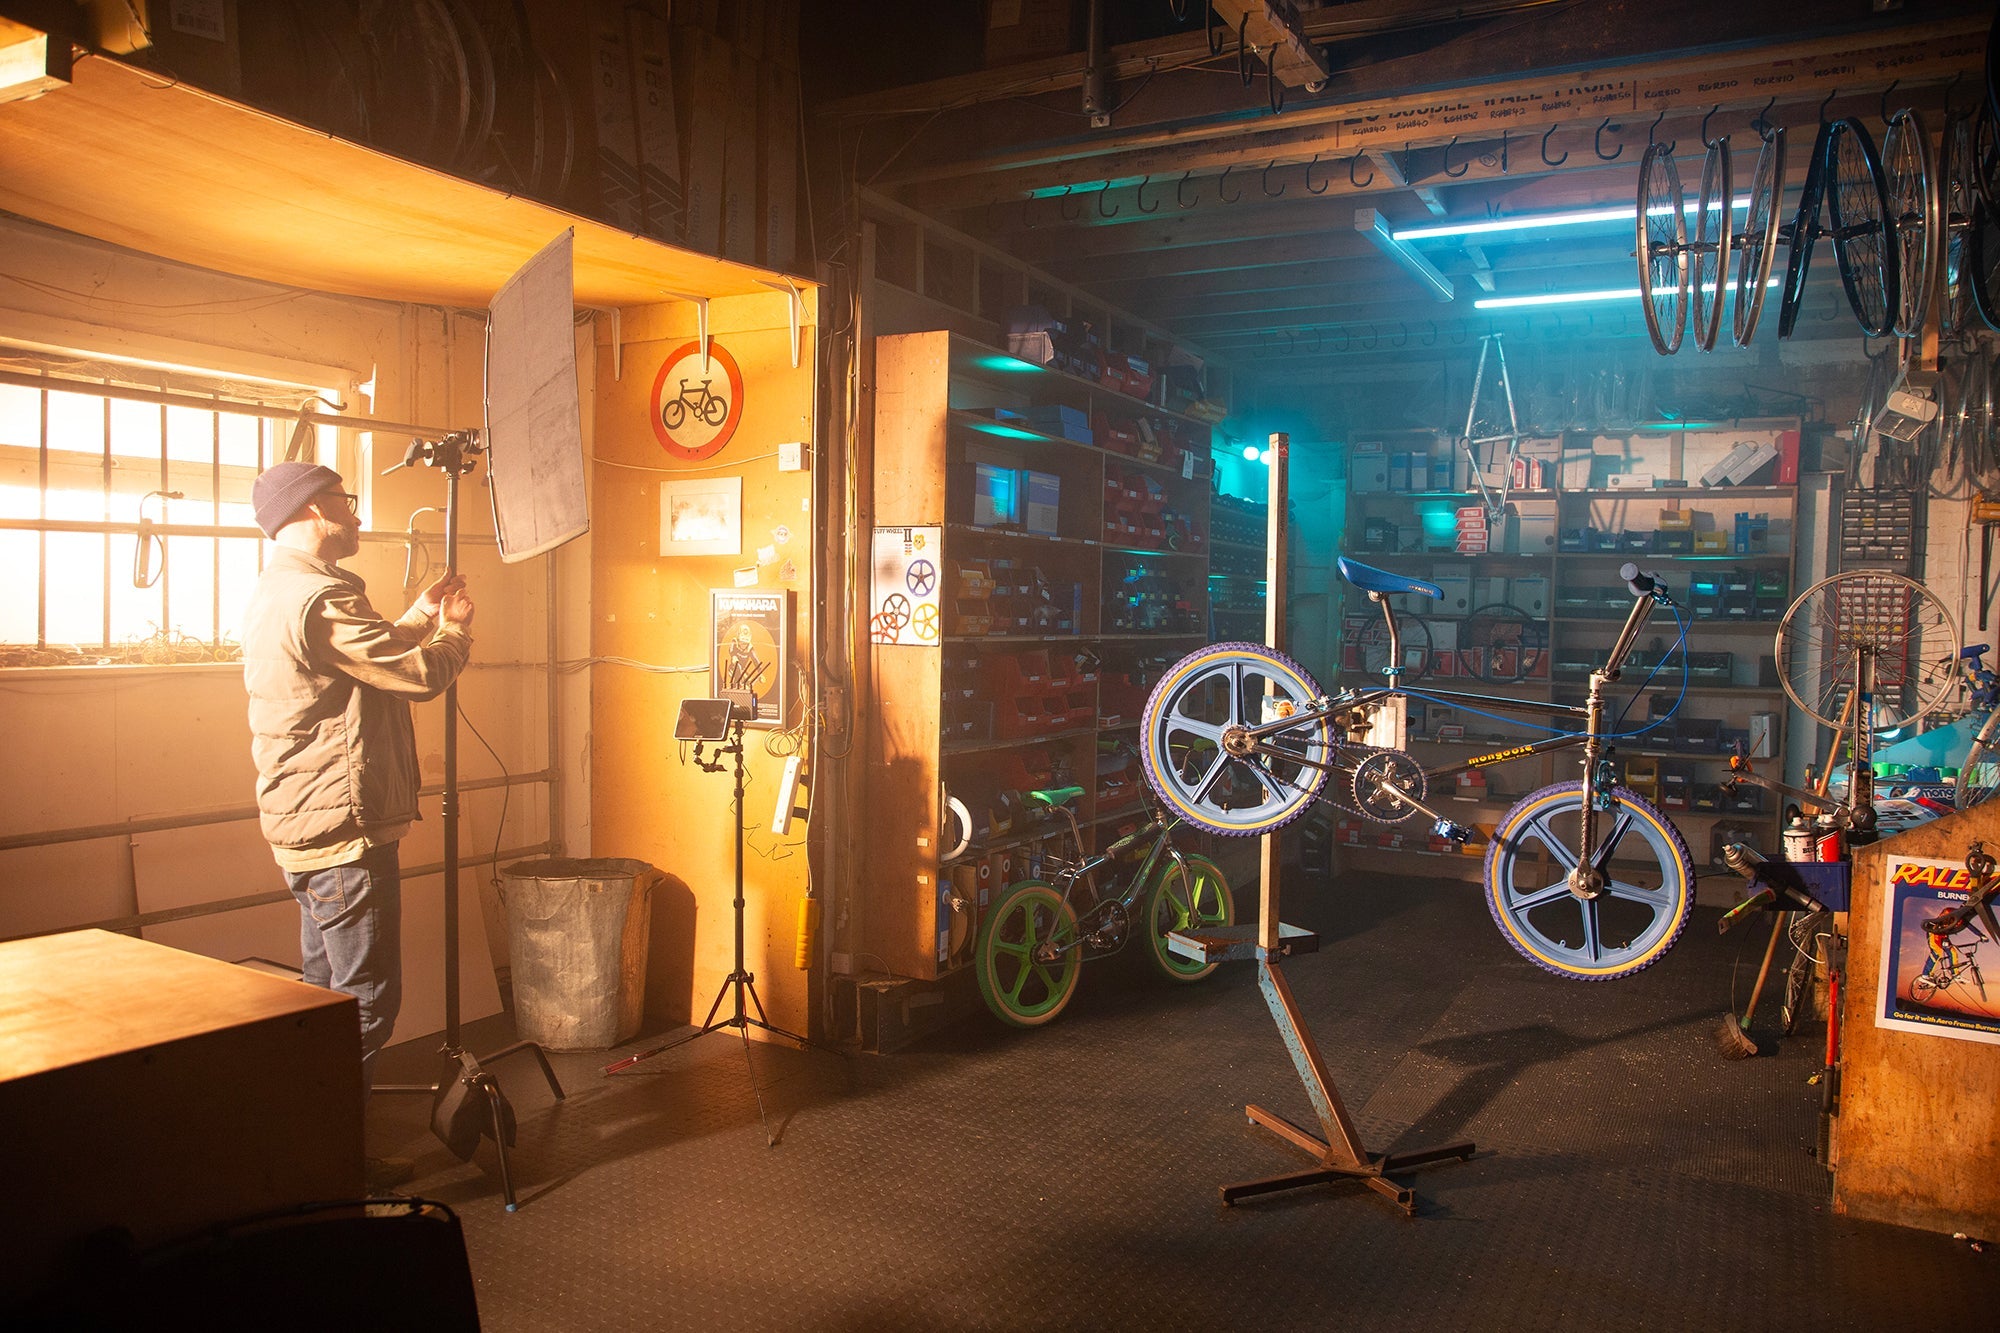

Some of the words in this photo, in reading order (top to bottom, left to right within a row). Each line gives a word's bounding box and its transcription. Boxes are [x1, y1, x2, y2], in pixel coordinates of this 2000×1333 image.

[719, 598, 778, 612] KUWAHARA
[1468, 745, 1533, 765] mongoose
[1890, 863, 2000, 891] RALE
[1937, 891, 1970, 902] BURNE
[1893, 1011, 1904, 1019] Go
[1904, 1012, 1914, 1020] for
[1920, 1015, 1936, 1023] with
[1936, 1018, 1953, 1026] Aero
[1953, 1020, 1975, 1029] Frame
